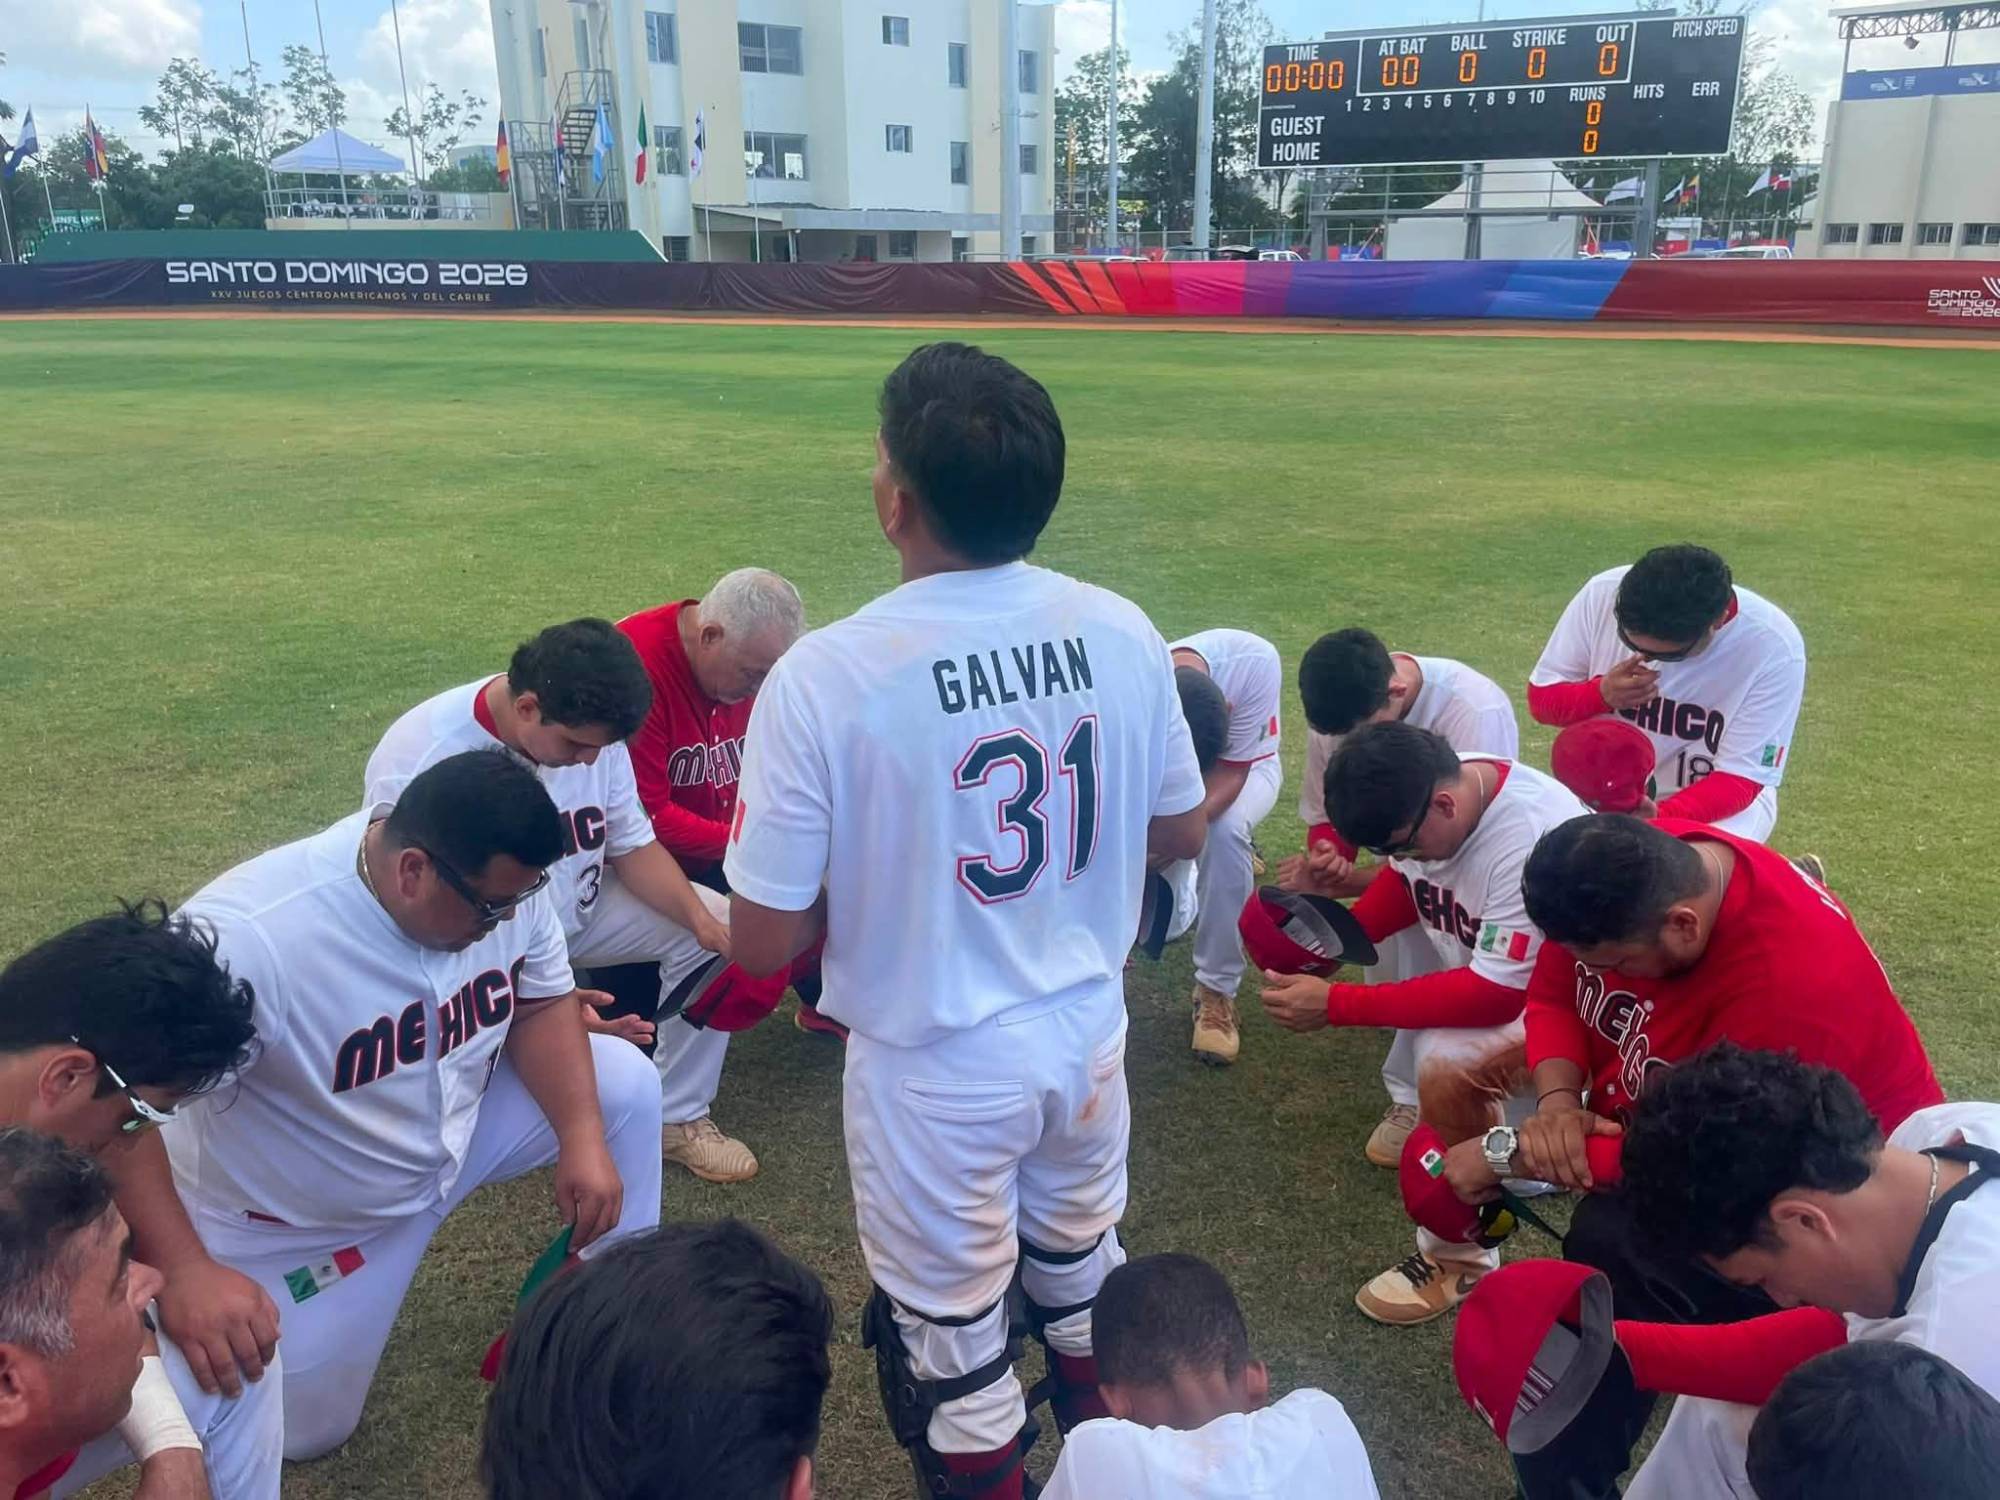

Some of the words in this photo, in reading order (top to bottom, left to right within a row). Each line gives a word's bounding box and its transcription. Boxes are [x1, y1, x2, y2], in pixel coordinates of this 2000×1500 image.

[1512, 28, 1567, 48] STRIKE
[1596, 24, 1629, 43] OUT
[1672, 20, 1701, 38] PITCH
[1705, 19, 1738, 37] SPEED
[1378, 39, 1397, 56] AT
[1399, 37, 1427, 55] BAT
[1451, 33, 1488, 52] BALL
[1286, 44, 1319, 62] TIME
[1527, 47, 1547, 79] 0
[1599, 43, 1618, 76] 0
[1266, 60, 1344, 93] 00:00
[1382, 56, 1420, 87] 00
[1459, 51, 1478, 83] 0
[1569, 86, 1607, 102] RUNS
[1633, 84, 1665, 99] HITS
[1692, 81, 1720, 97] ERR
[1345, 99, 1352, 112] 1
[1362, 98, 1371, 111] 2
[1382, 97, 1391, 110] 3
[1404, 96, 1412, 109] 4
[1423, 95, 1432, 108] 5
[1443, 94, 1452, 107] 6
[1467, 93, 1476, 106] 7
[1486, 92, 1495, 106] 8
[1507, 90, 1516, 104] 9
[1528, 89, 1545, 104] 10
[1586, 101, 1601, 126] 0
[1271, 116, 1325, 137] GUEST
[1583, 129, 1599, 154] 0
[1272, 142, 1321, 162] HOME
[166, 261, 277, 283] SANTO
[285, 262, 429, 285] DOMINGO
[438, 263, 528, 286] 2026
[210, 290, 232, 299] XXV
[237, 290, 282, 299] JUEGOS
[286, 290, 408, 301] CENTROAMERICANOS
[413, 292, 418, 301] Y
[423, 292, 444, 301] DEL
[449, 292, 491, 302] CARIBE
[1927, 299, 1997, 308] DOMINGO
[1929, 289, 1982, 299] SANTO
[1961, 307, 2000, 318] 2026
[932, 637, 1094, 714] GALVAN
[953, 714, 1101, 905] 31
